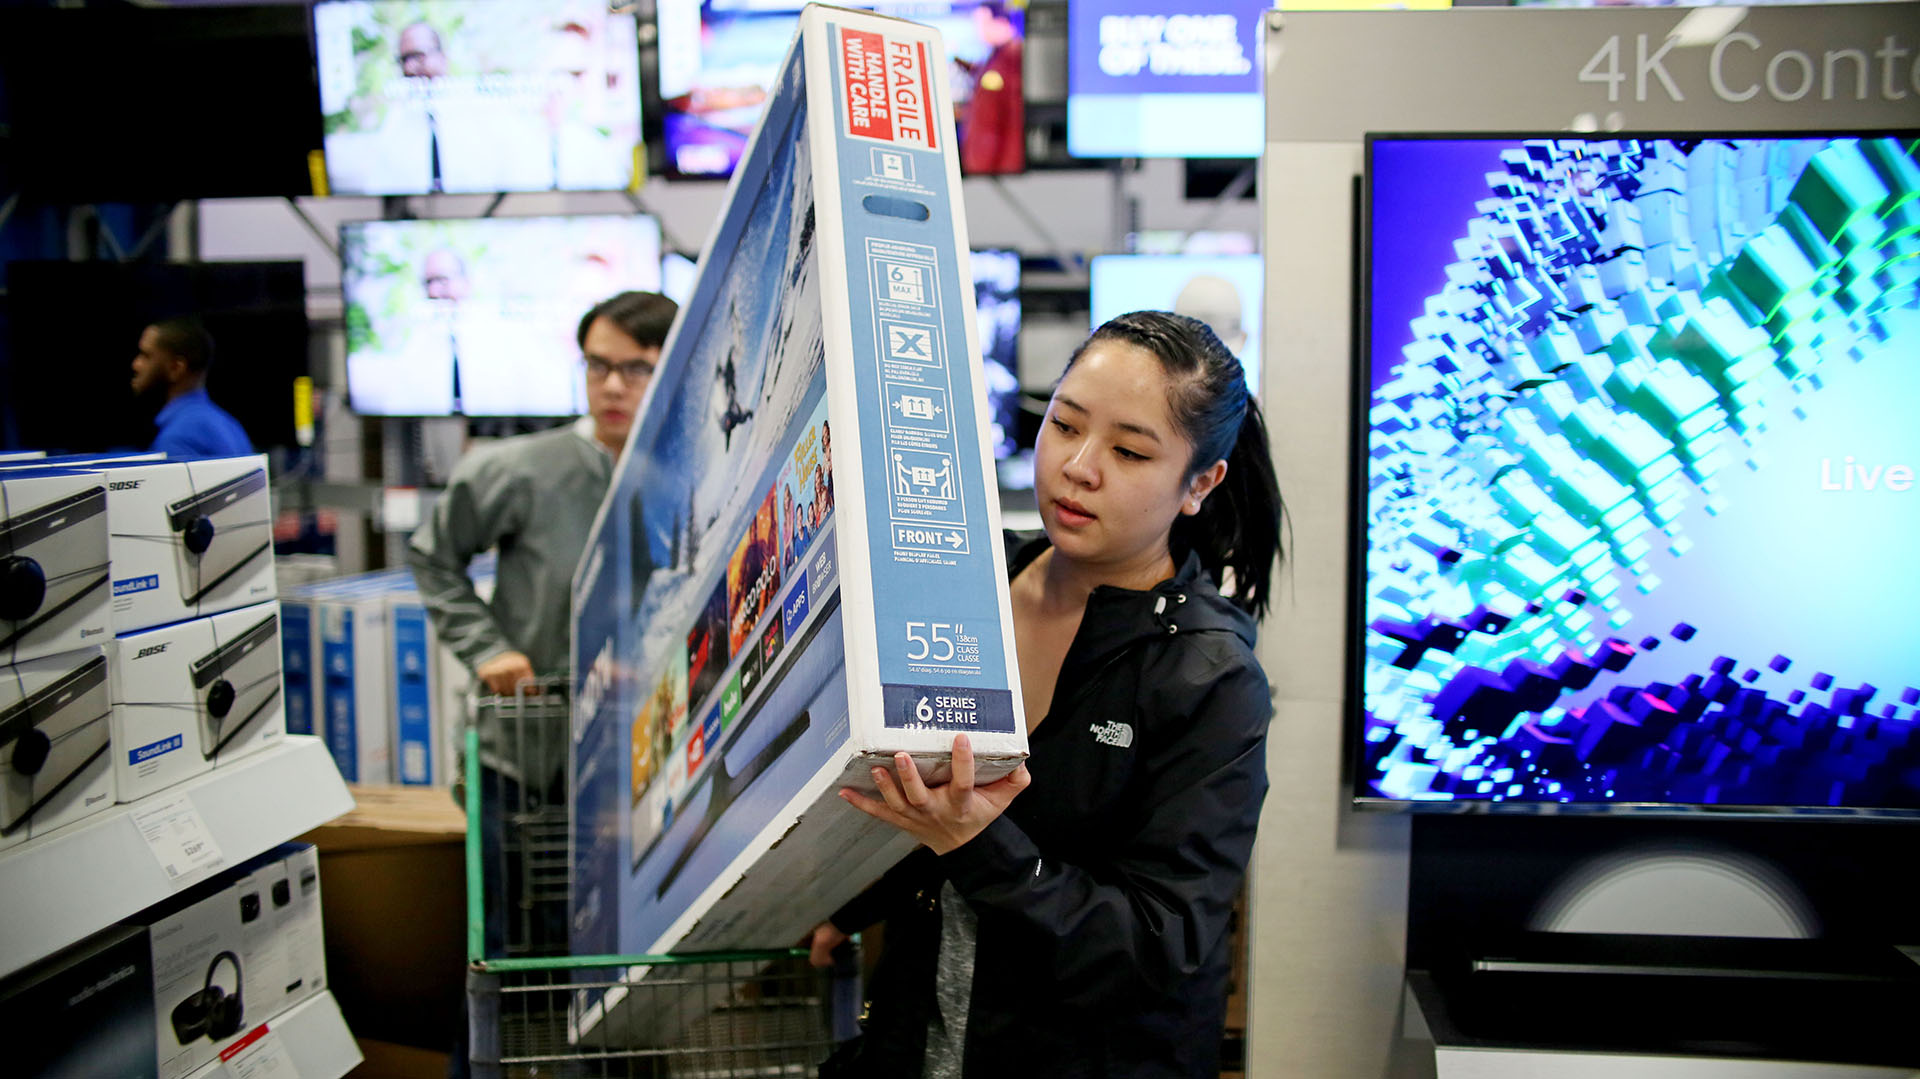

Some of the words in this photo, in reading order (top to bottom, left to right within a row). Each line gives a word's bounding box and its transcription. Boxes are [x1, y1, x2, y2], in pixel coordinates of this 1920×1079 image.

[846, 38, 866, 80] WITH
[1578, 34, 1685, 102] 4K
[1709, 31, 1920, 102] Cont
[865, 51, 888, 120] HANDLE
[891, 41, 921, 141] FRAGILE
[850, 82, 871, 128] CARE
[891, 267, 904, 281] 6
[893, 285, 912, 294] MAX
[1821, 455, 1915, 491] Live
[898, 529, 943, 544] FRONT
[793, 590, 805, 617] APPS
[136, 643, 168, 659] BOSE
[956, 646, 979, 655] CLASS
[957, 654, 980, 663] CLASSE
[916, 696, 934, 722] 6
[935, 696, 976, 709] SERIES
[936, 709, 978, 724] SÉRIE
[1090, 723, 1120, 738] NORTH
[1107, 720, 1123, 730] THE
[1095, 734, 1120, 745] FACE
